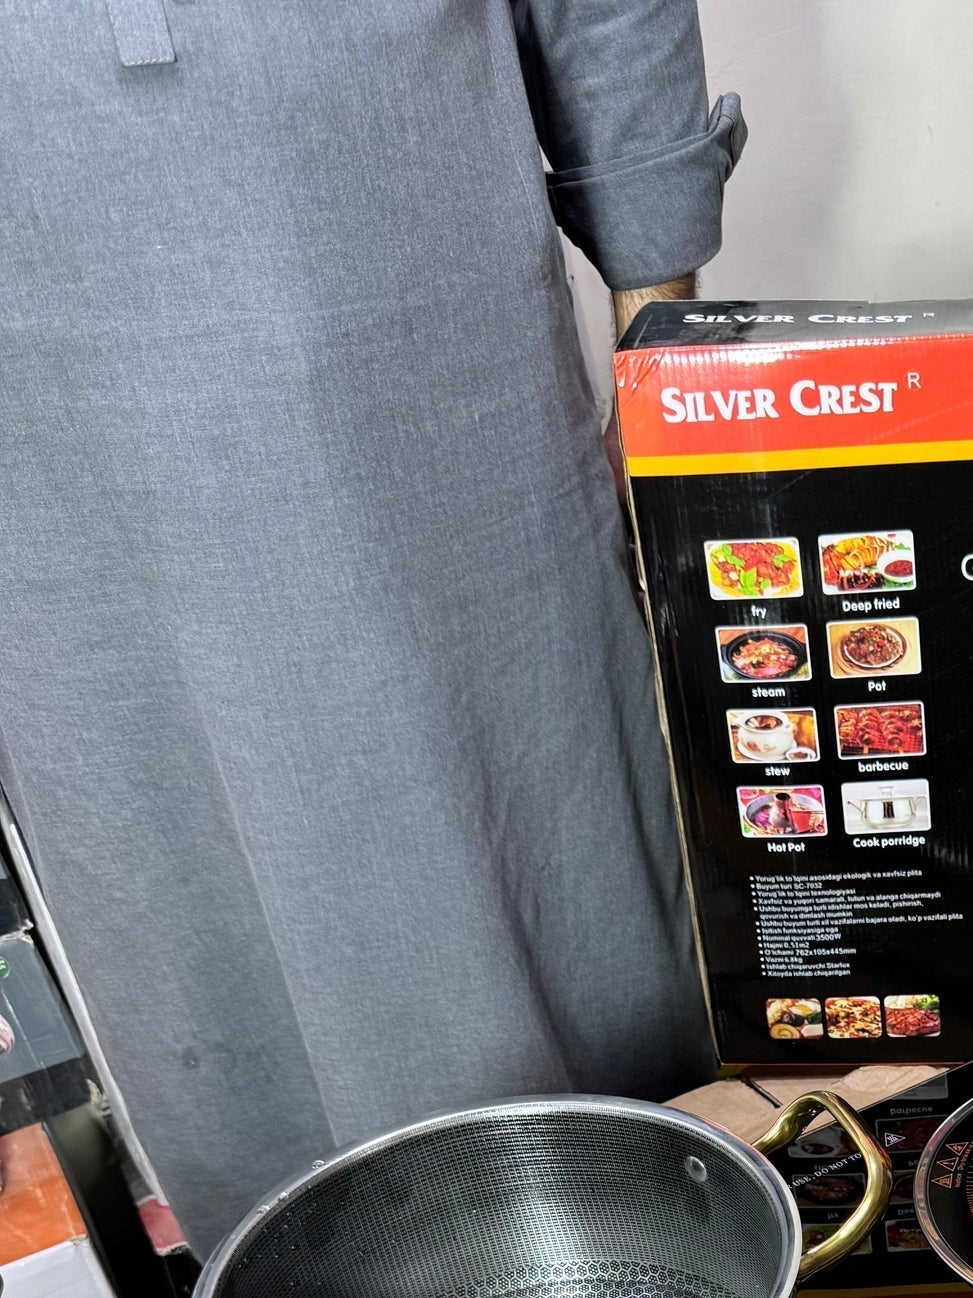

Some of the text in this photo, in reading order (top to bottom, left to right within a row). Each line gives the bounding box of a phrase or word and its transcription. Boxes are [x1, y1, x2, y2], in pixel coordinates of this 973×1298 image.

[682, 313, 795, 324] SILVER
[807, 313, 913, 324] CREST
[660, 386, 780, 424] SILVER
[789, 380, 898, 417] CREST
[841, 597, 901, 614] Deep fried
[750, 605, 767, 620] fry
[751, 687, 786, 698] steam
[867, 681, 887, 692] Pot
[764, 765, 791, 777] stew
[857, 760, 909, 773] barbecue
[767, 841, 806, 853] Hot Pot
[852, 834, 926, 849] Cook porridge
